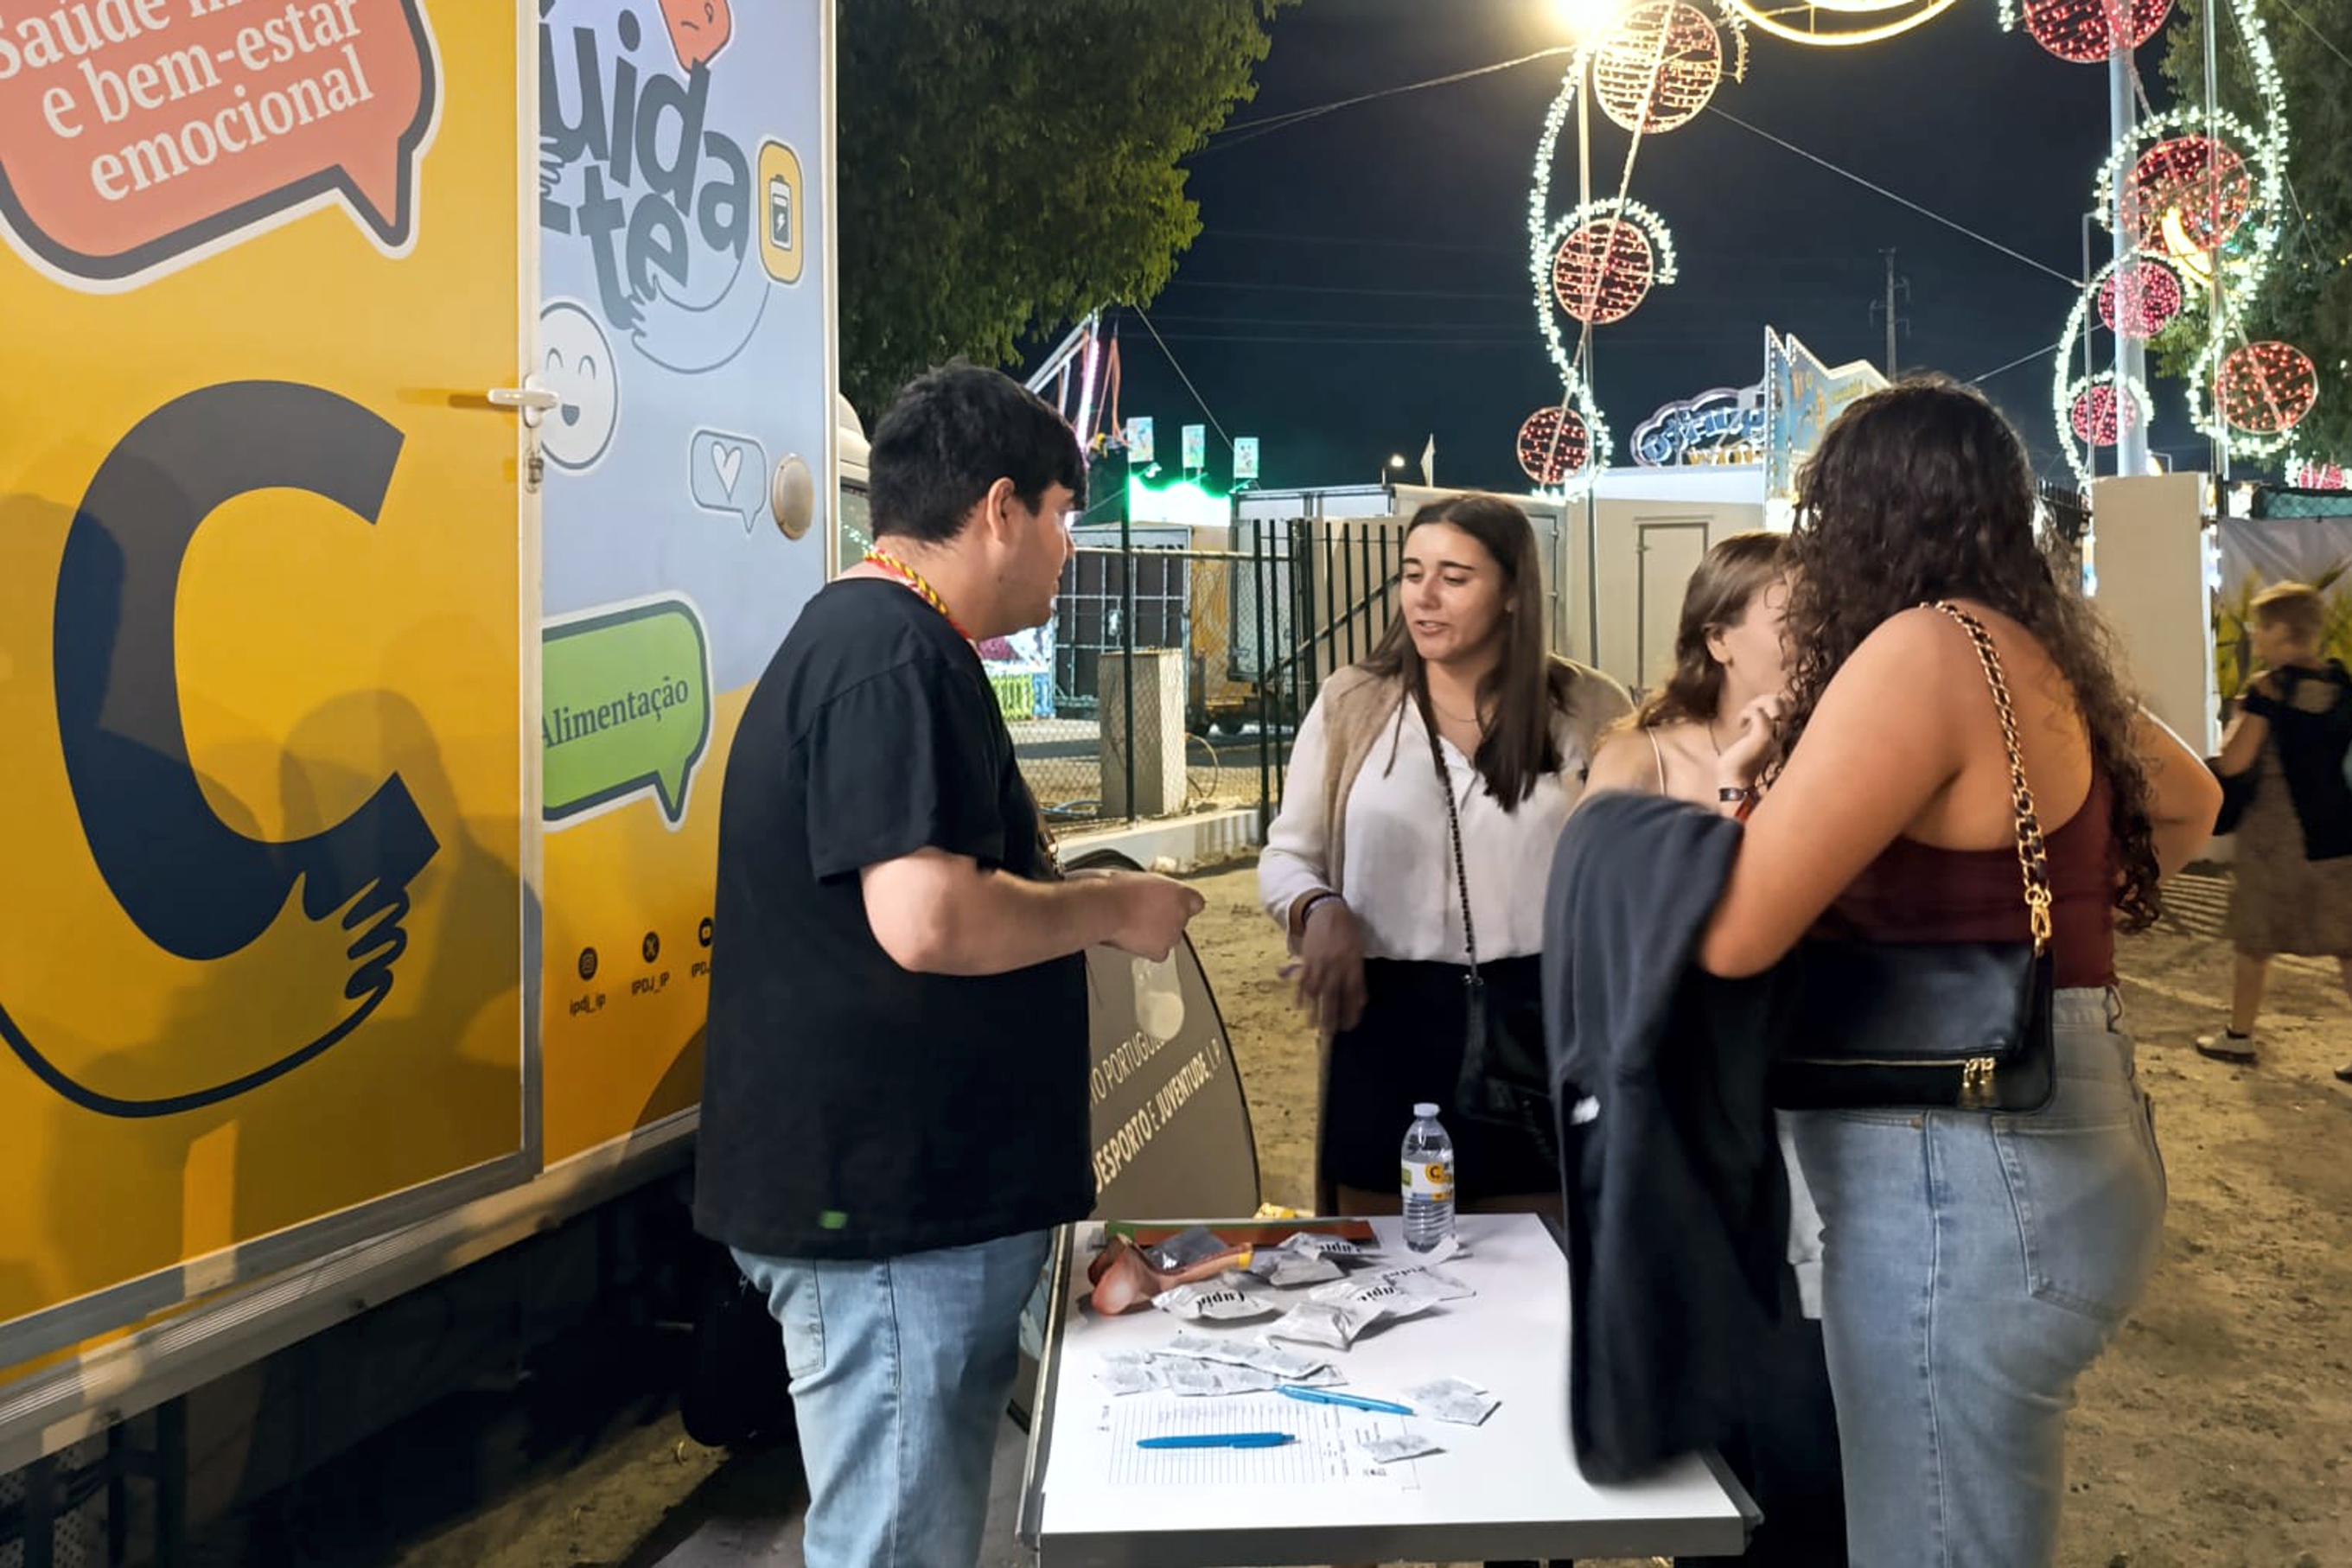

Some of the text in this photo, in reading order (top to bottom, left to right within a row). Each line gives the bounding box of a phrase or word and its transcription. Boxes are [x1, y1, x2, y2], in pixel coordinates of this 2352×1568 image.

[42, 0, 362, 138] e bem-estar
[91, 44, 375, 203] emocional
[539, 7, 750, 262] uida
[542, 673, 690, 749] Alimentação
[631, 972, 670, 995] IPDJ_IP
[691, 961, 711, 978] IPD
[1102, 1031, 1166, 1090] PORTUGU
[1146, 1100, 1160, 1131] E
